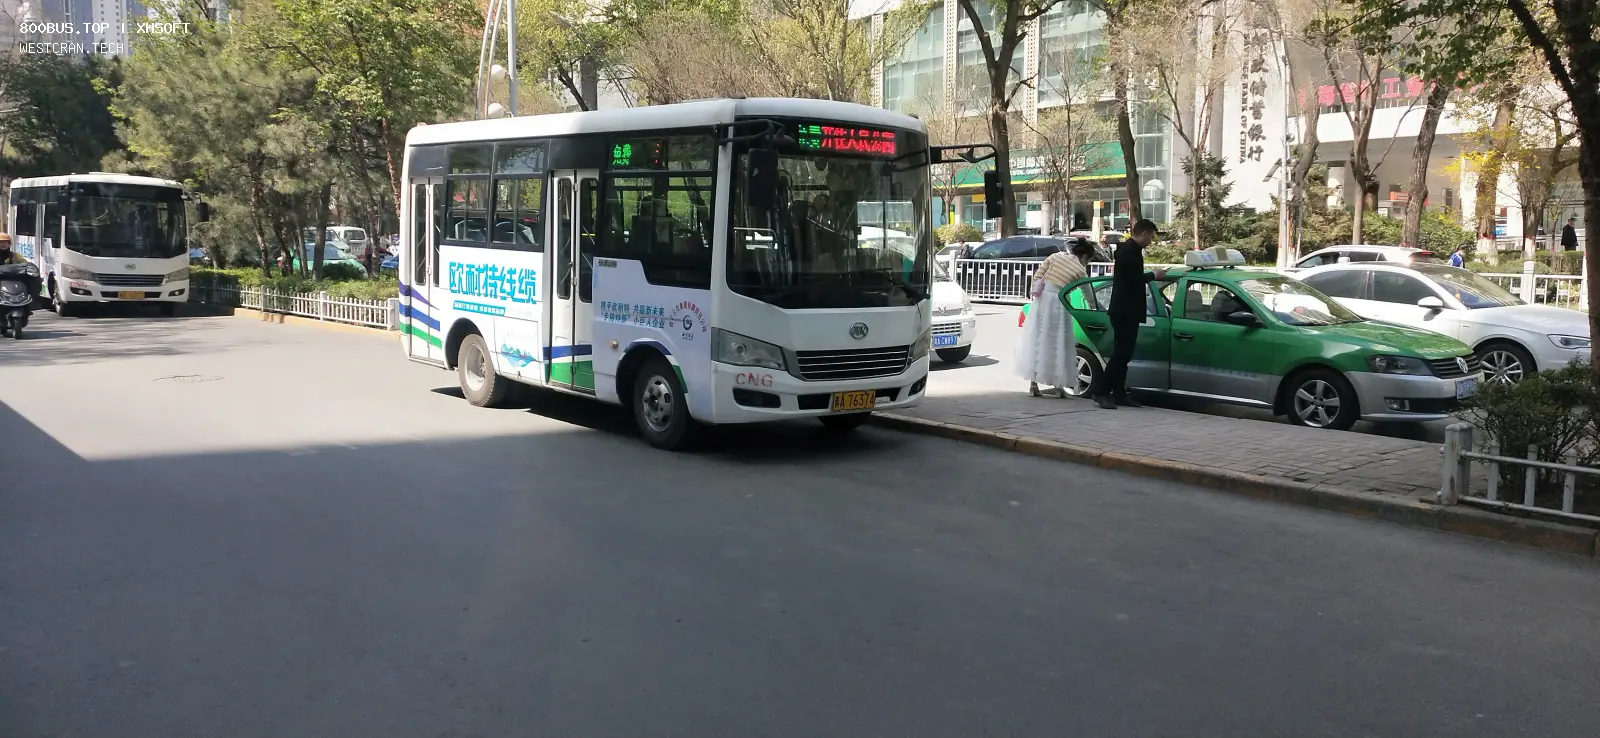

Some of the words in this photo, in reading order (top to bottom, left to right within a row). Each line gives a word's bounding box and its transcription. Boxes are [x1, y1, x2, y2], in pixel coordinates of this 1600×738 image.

[449, 261, 537, 305] 欧耐特线缆
[735, 372, 773, 387] CNG
[847, 393, 875, 409] 76374
